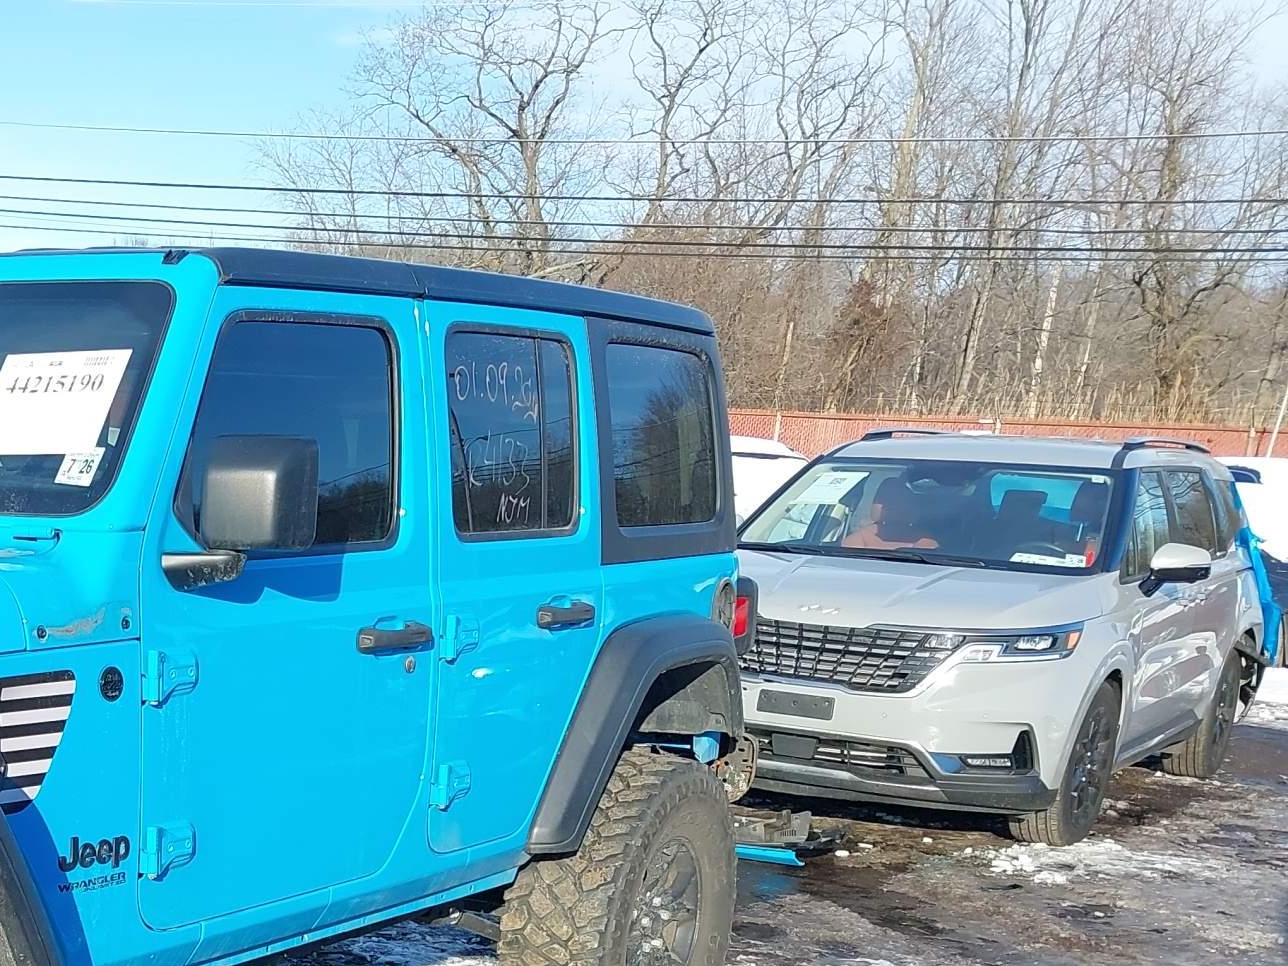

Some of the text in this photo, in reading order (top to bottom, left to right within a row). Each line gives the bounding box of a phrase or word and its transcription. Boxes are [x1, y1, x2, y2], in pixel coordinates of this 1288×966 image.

[6, 373, 105, 393] 44215190
[78, 459, 95, 475] 26
[58, 836, 130, 872] Jeep
[57, 872, 126, 893] WRANGLER
